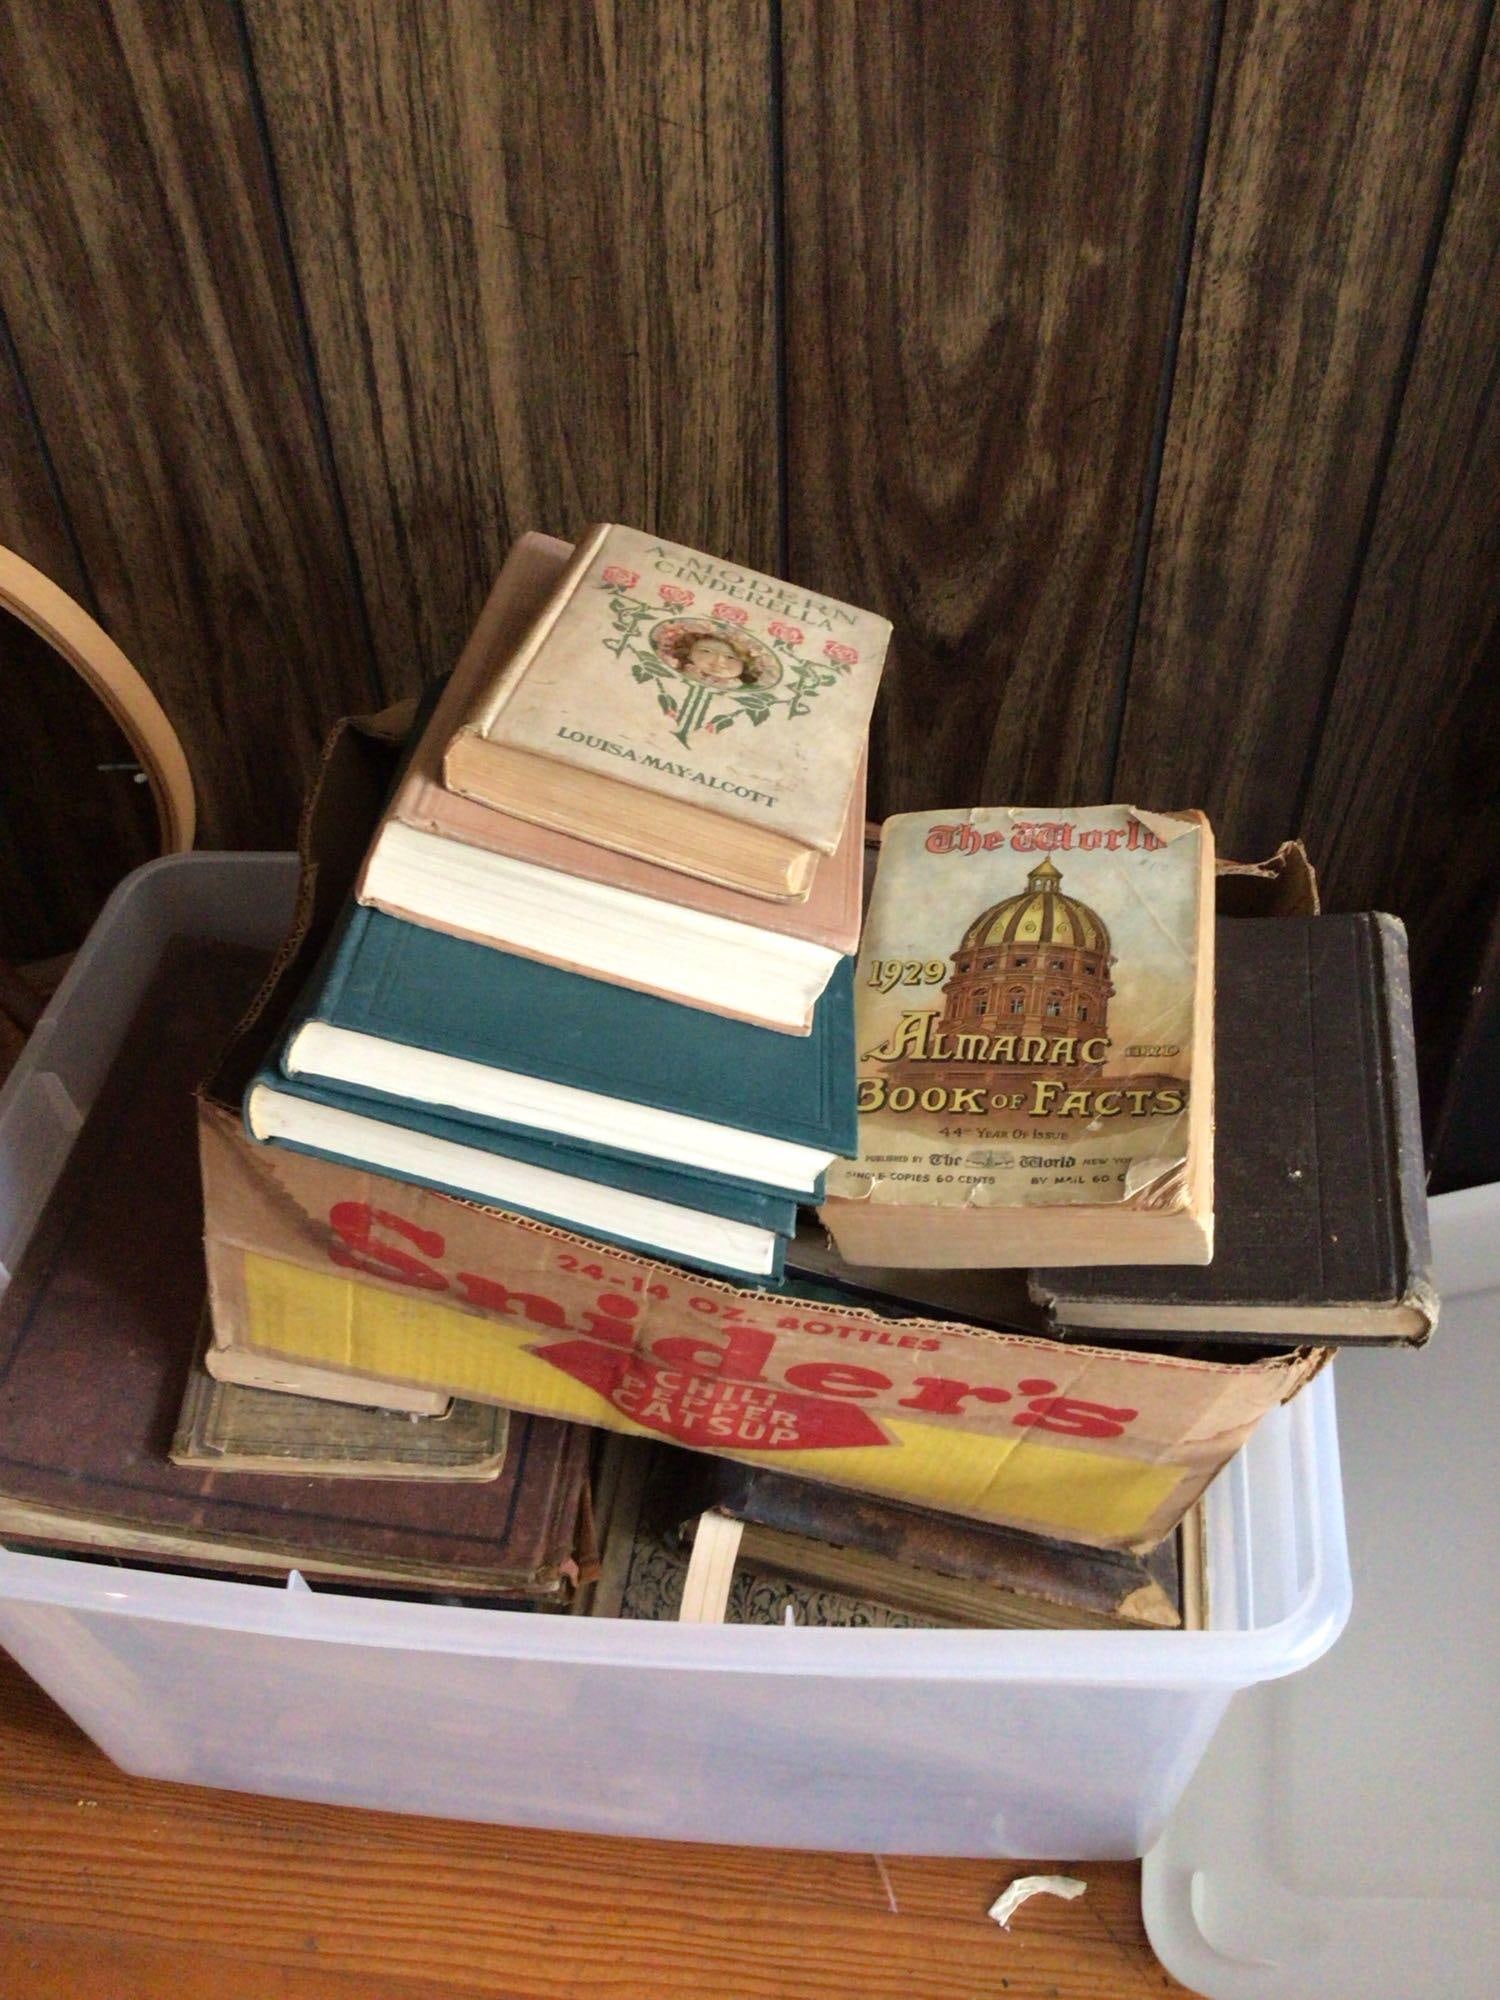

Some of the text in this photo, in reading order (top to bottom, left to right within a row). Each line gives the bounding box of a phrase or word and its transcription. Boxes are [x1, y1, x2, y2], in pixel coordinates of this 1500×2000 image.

[646, 546, 858, 626] A MODERN
[655, 560, 833, 632] CINDERELLA
[557, 726, 779, 808] LOUISA MAY ALCOTT
[924, 819, 1168, 856] The World
[867, 958, 948, 995] 1929
[861, 1009, 1112, 1064] ALMANAC
[857, 1076, 1189, 1118] BOOK OF FACTS
[976, 1127, 1008, 1139] YEAR
[890, 1172, 930, 1183] COPIES
[936, 1174, 953, 1183] 60
[958, 1175, 995, 1184] CENTS
[1020, 1155, 1076, 1169] World
[1030, 1176, 1047, 1185] BY
[329, 1201, 1139, 1438] Snider's
[776, 1316, 941, 1353] BOTTLES
[622, 1373, 798, 1429] PEPPER
[655, 1371, 777, 1407] CHILI
[612, 1388, 800, 1445] CATSUP
